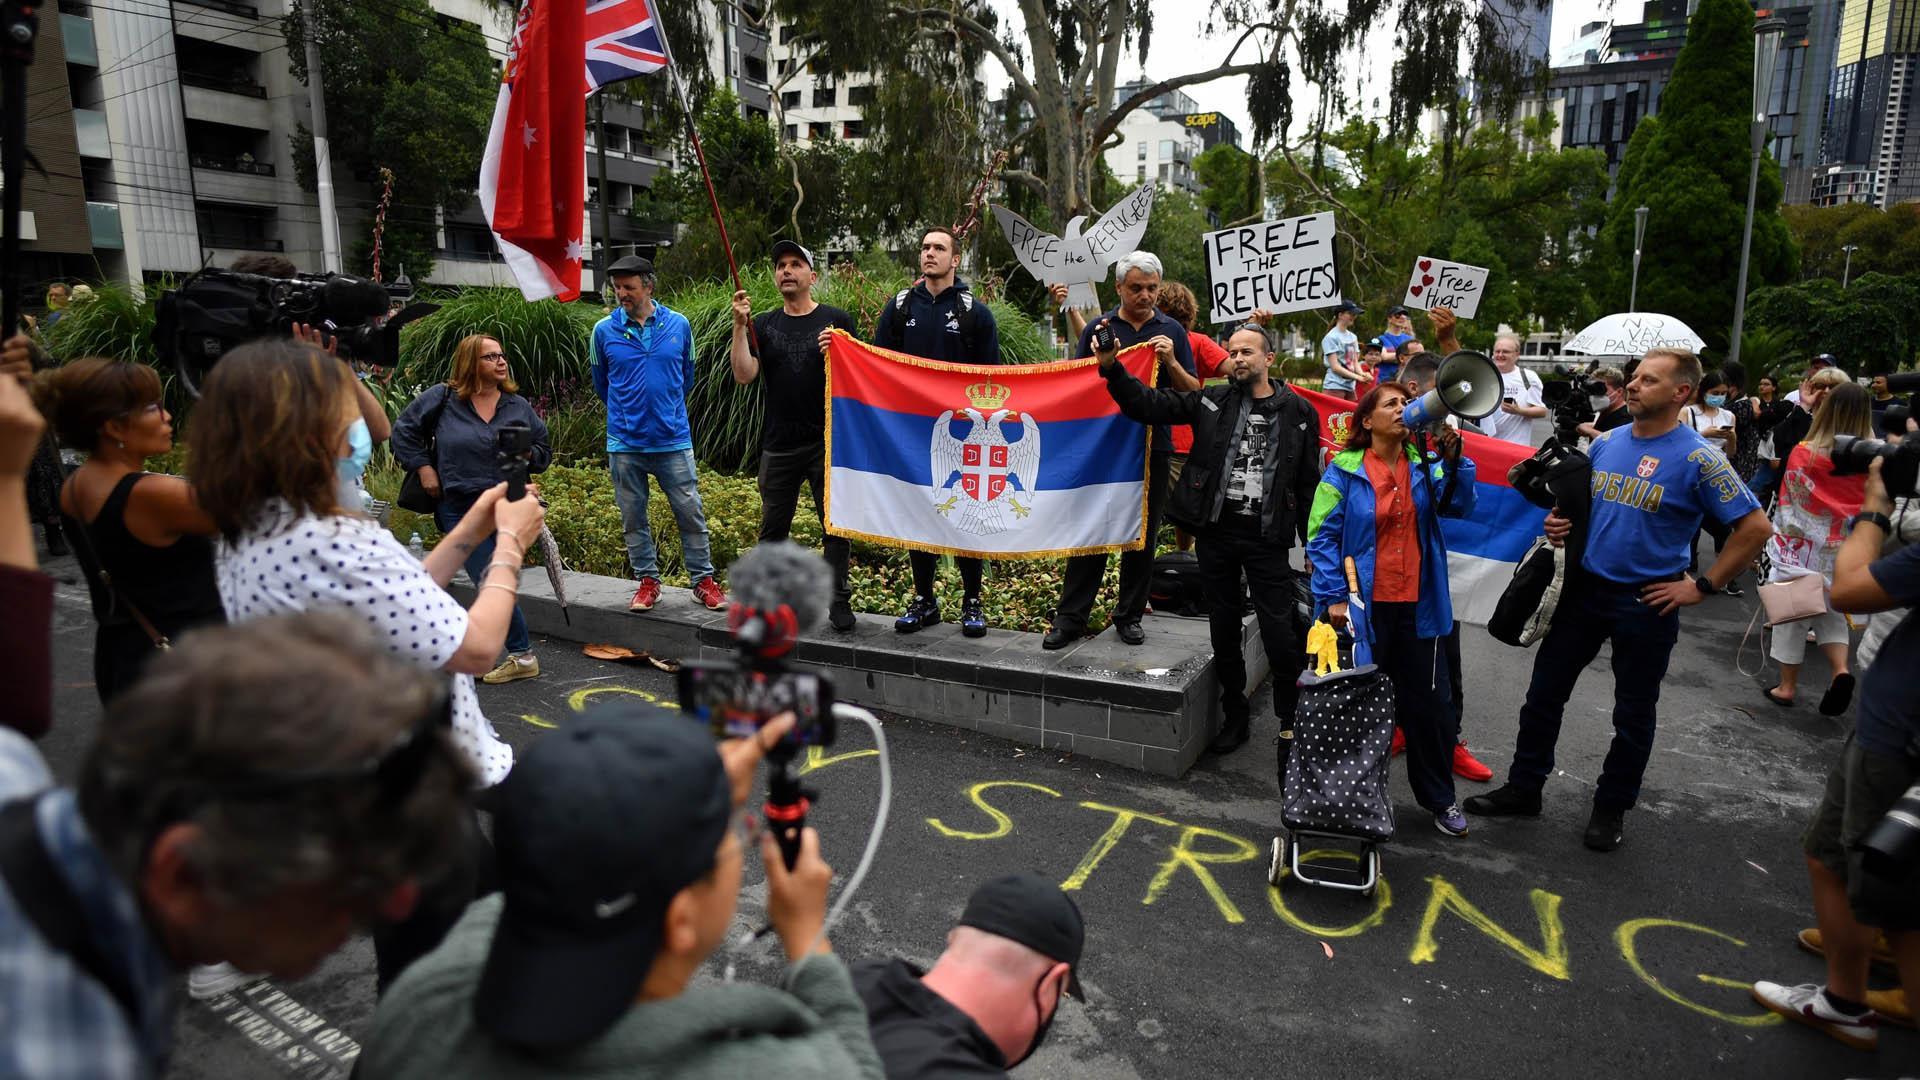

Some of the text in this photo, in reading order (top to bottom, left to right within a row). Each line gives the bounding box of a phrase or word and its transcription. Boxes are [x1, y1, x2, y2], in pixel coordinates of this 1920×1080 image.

[1185, 113, 1217, 128] scape
[1011, 184, 1153, 268] FREE the REFUGEES
[1215, 216, 1319, 266] FREE
[1242, 253, 1281, 272] THE
[1214, 262, 1335, 317] REFUGEES
[1438, 266, 1477, 292] Free
[1425, 287, 1465, 309] Hugs
[1622, 317, 1665, 328] NO
[1628, 327, 1665, 340] VAX
[1591, 470, 1665, 513] РБИЈА
[926, 780, 1788, 1027] STRONG
